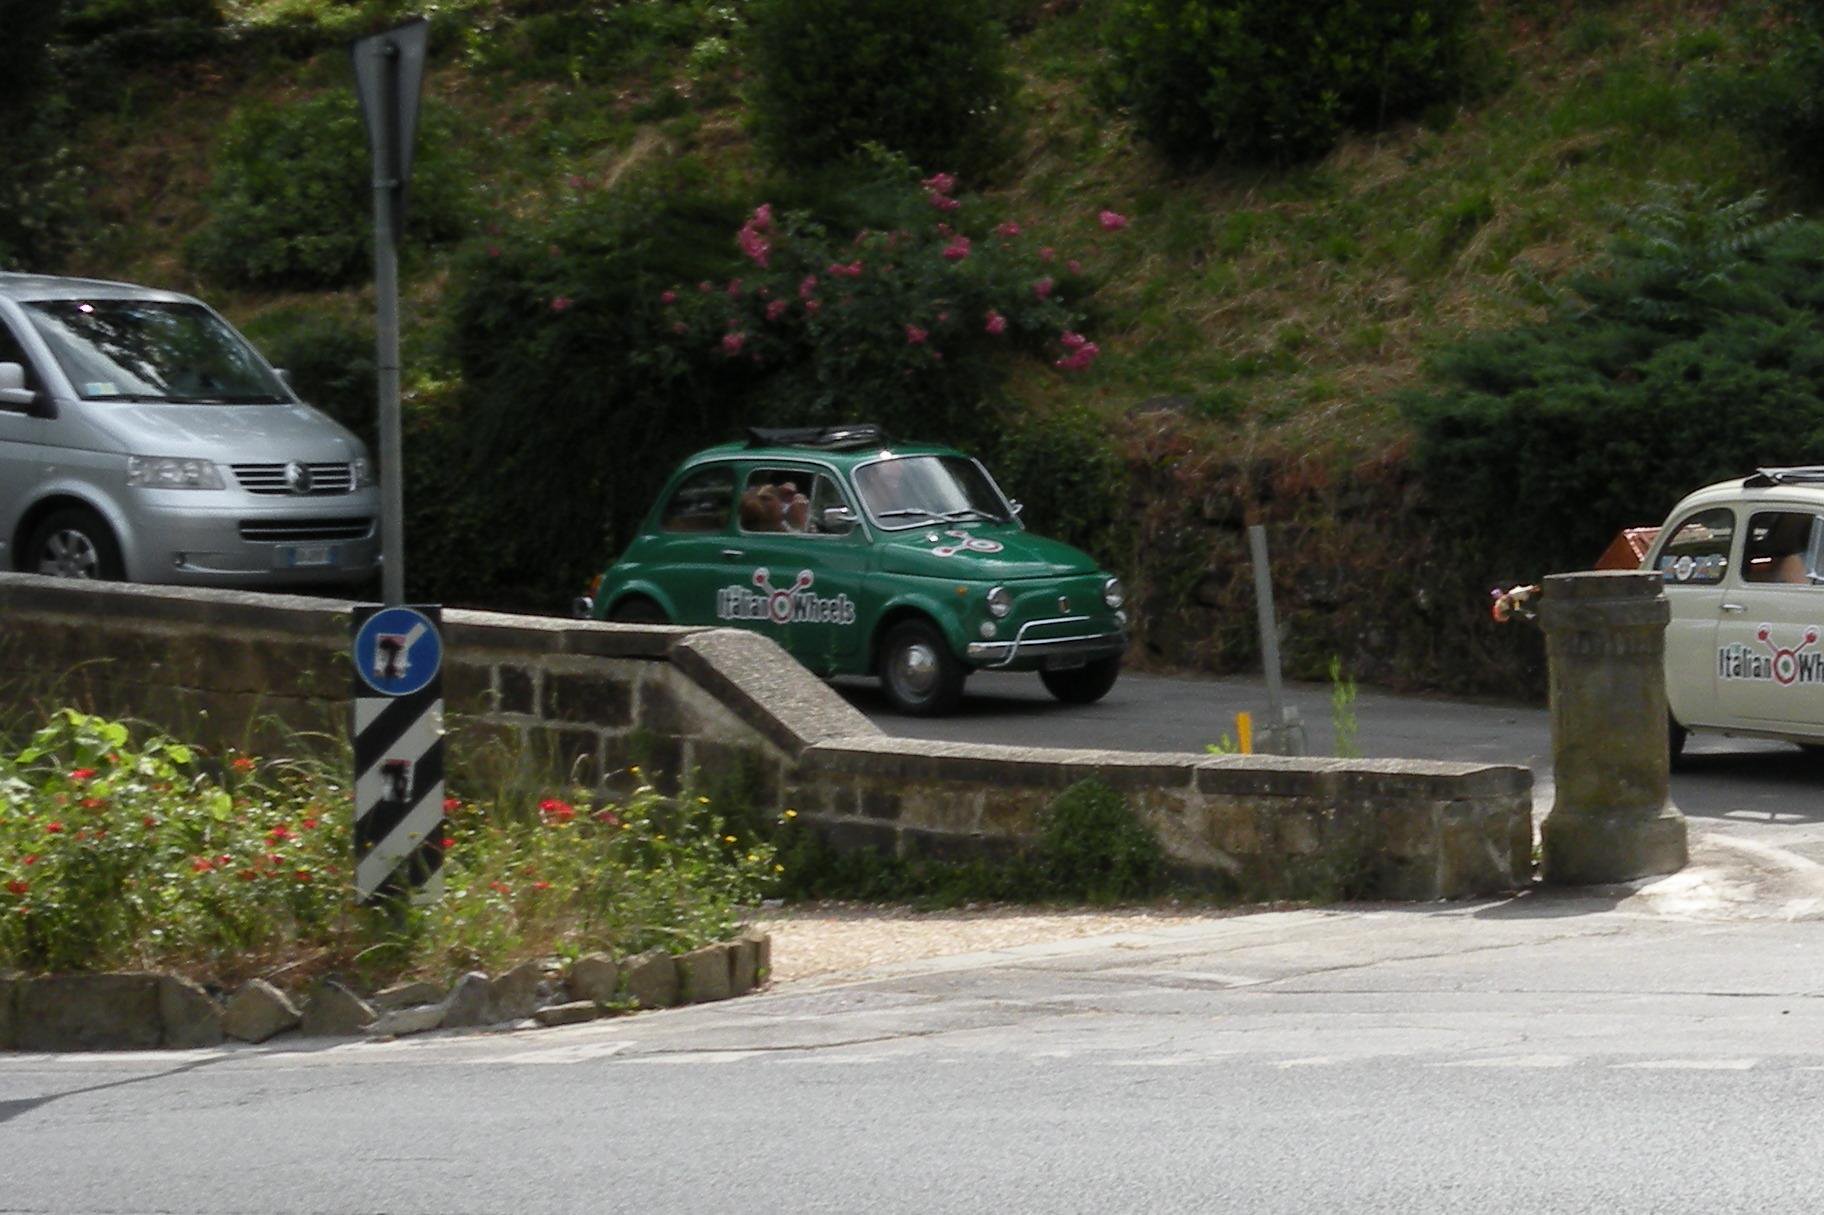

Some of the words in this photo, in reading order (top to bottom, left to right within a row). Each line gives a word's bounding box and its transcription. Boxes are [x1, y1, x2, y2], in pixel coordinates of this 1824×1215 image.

[718, 586, 769, 619] Italian
[794, 592, 855, 624] Wheels
[1718, 645, 1771, 679] Italian
